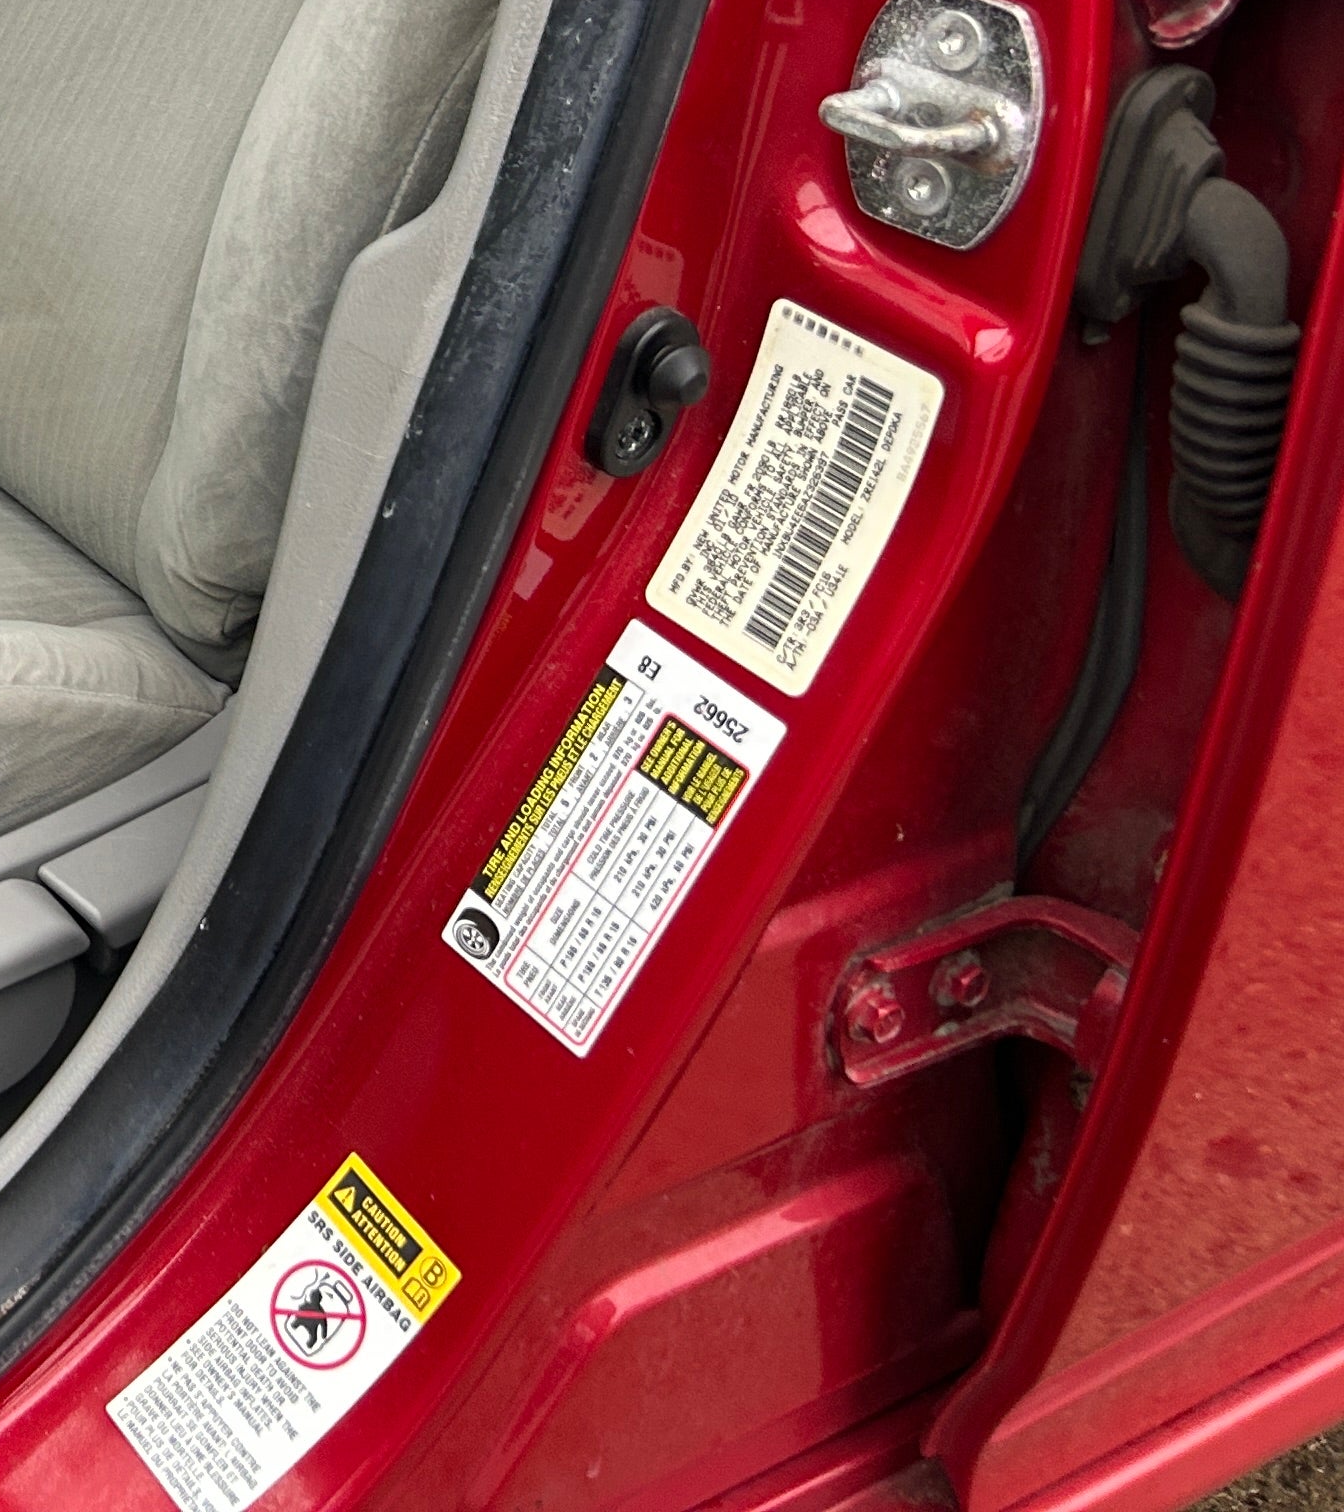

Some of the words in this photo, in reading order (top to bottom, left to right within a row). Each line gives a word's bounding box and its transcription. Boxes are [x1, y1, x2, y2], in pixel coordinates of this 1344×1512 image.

[830, 399, 848, 426] PASS
[841, 374, 857, 395] CAR
[693, 528, 708, 550] NEW
[706, 487, 729, 526] UNITED
[728, 451, 748, 484] MOTOR
[742, 363, 786, 446] MANUFACTURING
[694, 584, 711, 610] THIS
[709, 537, 737, 583] VEHICLE
[735, 481, 766, 536] CONFORMS
[763, 463, 774, 477] TO
[771, 439, 786, 459] ALL
[779, 372, 815, 434] APPLICABLE
[702, 571, 730, 617] FEDERAL
[729, 534, 750, 569] MOTOR
[749, 487, 775, 532] VEHICLE
[809, 368, 824, 389] AND
[711, 589, 731, 622] THEFT
[731, 522, 768, 589] PREVENTION
[766, 461, 799, 521] STANDARDS
[796, 443, 807, 456] IN
[802, 403, 825, 439] EFFECT
[819, 382, 831, 397] ON
[720, 607, 734, 627] THE
[733, 576, 752, 605] DATE
[750, 559, 761, 574] OF
[760, 484, 800, 557] MANUFACTURE
[798, 447, 817, 480] SHOWN
[637, 654, 662, 680] E8
[541, 810, 556, 831] TOTAL
[589, 752, 598, 761] 2
[623, 695, 632, 704] 3
[640, 755, 654, 772] SEE
[649, 720, 675, 757] OWNER'S
[650, 744, 674, 779] MANUAL
[670, 727, 684, 745] FOR
[660, 736, 693, 784] ADDITIONAL
[691, 694, 748, 743] 25662
[482, 848, 504, 878] TIRE
[499, 821, 521, 850] AND
[516, 767, 554, 823] LOADING
[549, 683, 605, 768] INFORMATION
[484, 822, 534, 898] RENSEIGNEMENTS
[529, 804, 545, 825] SUR
[540, 788, 555, 806] LES
[550, 759, 572, 790] PNEUS
[567, 747, 580, 762] ET
[574, 735, 587, 749] LE
[581, 678, 622, 738] CHARGEMENT
[668, 740, 704, 794] INFORMATION
[350, 1209, 407, 1272] ATTENTION
[360, 1196, 407, 1248] CAUTION
[306, 1210, 335, 1241] SRS
[331, 1239, 364, 1275] SIDE
[360, 1273, 412, 1331] AIRBAG
[424, 1261, 446, 1286] B
[180, 1351, 197, 1370] FOR
[188, 1343, 204, 1360] SEE
[231, 1397, 266, 1436] MANUAL
[197, 1335, 216, 1356] SIDE
[212, 1355, 241, 1387] AIRBAG
[204, 1327, 237, 1364] SERIOUS
[234, 1363, 263, 1394] INJURY
[259, 1394, 283, 1421] WHEN
[280, 1420, 298, 1440] THE
[212, 1319, 253, 1364] POTENTIAL
[249, 1363, 274, 1391] DEATH
[272, 1390, 285, 1405] OR
[221, 1310, 248, 1340] FRONT
[244, 1339, 267, 1364] DOOR
[265, 1363, 277, 1377] TO
[274, 1375, 299, 1404] AVOID
[230, 1303, 243, 1318] DO
[241, 1316, 258, 1335] NOT
[255, 1333, 276, 1357] LEAN
[273, 1356, 307, 1393] AGAINST
[302, 1391, 321, 1412] THE
